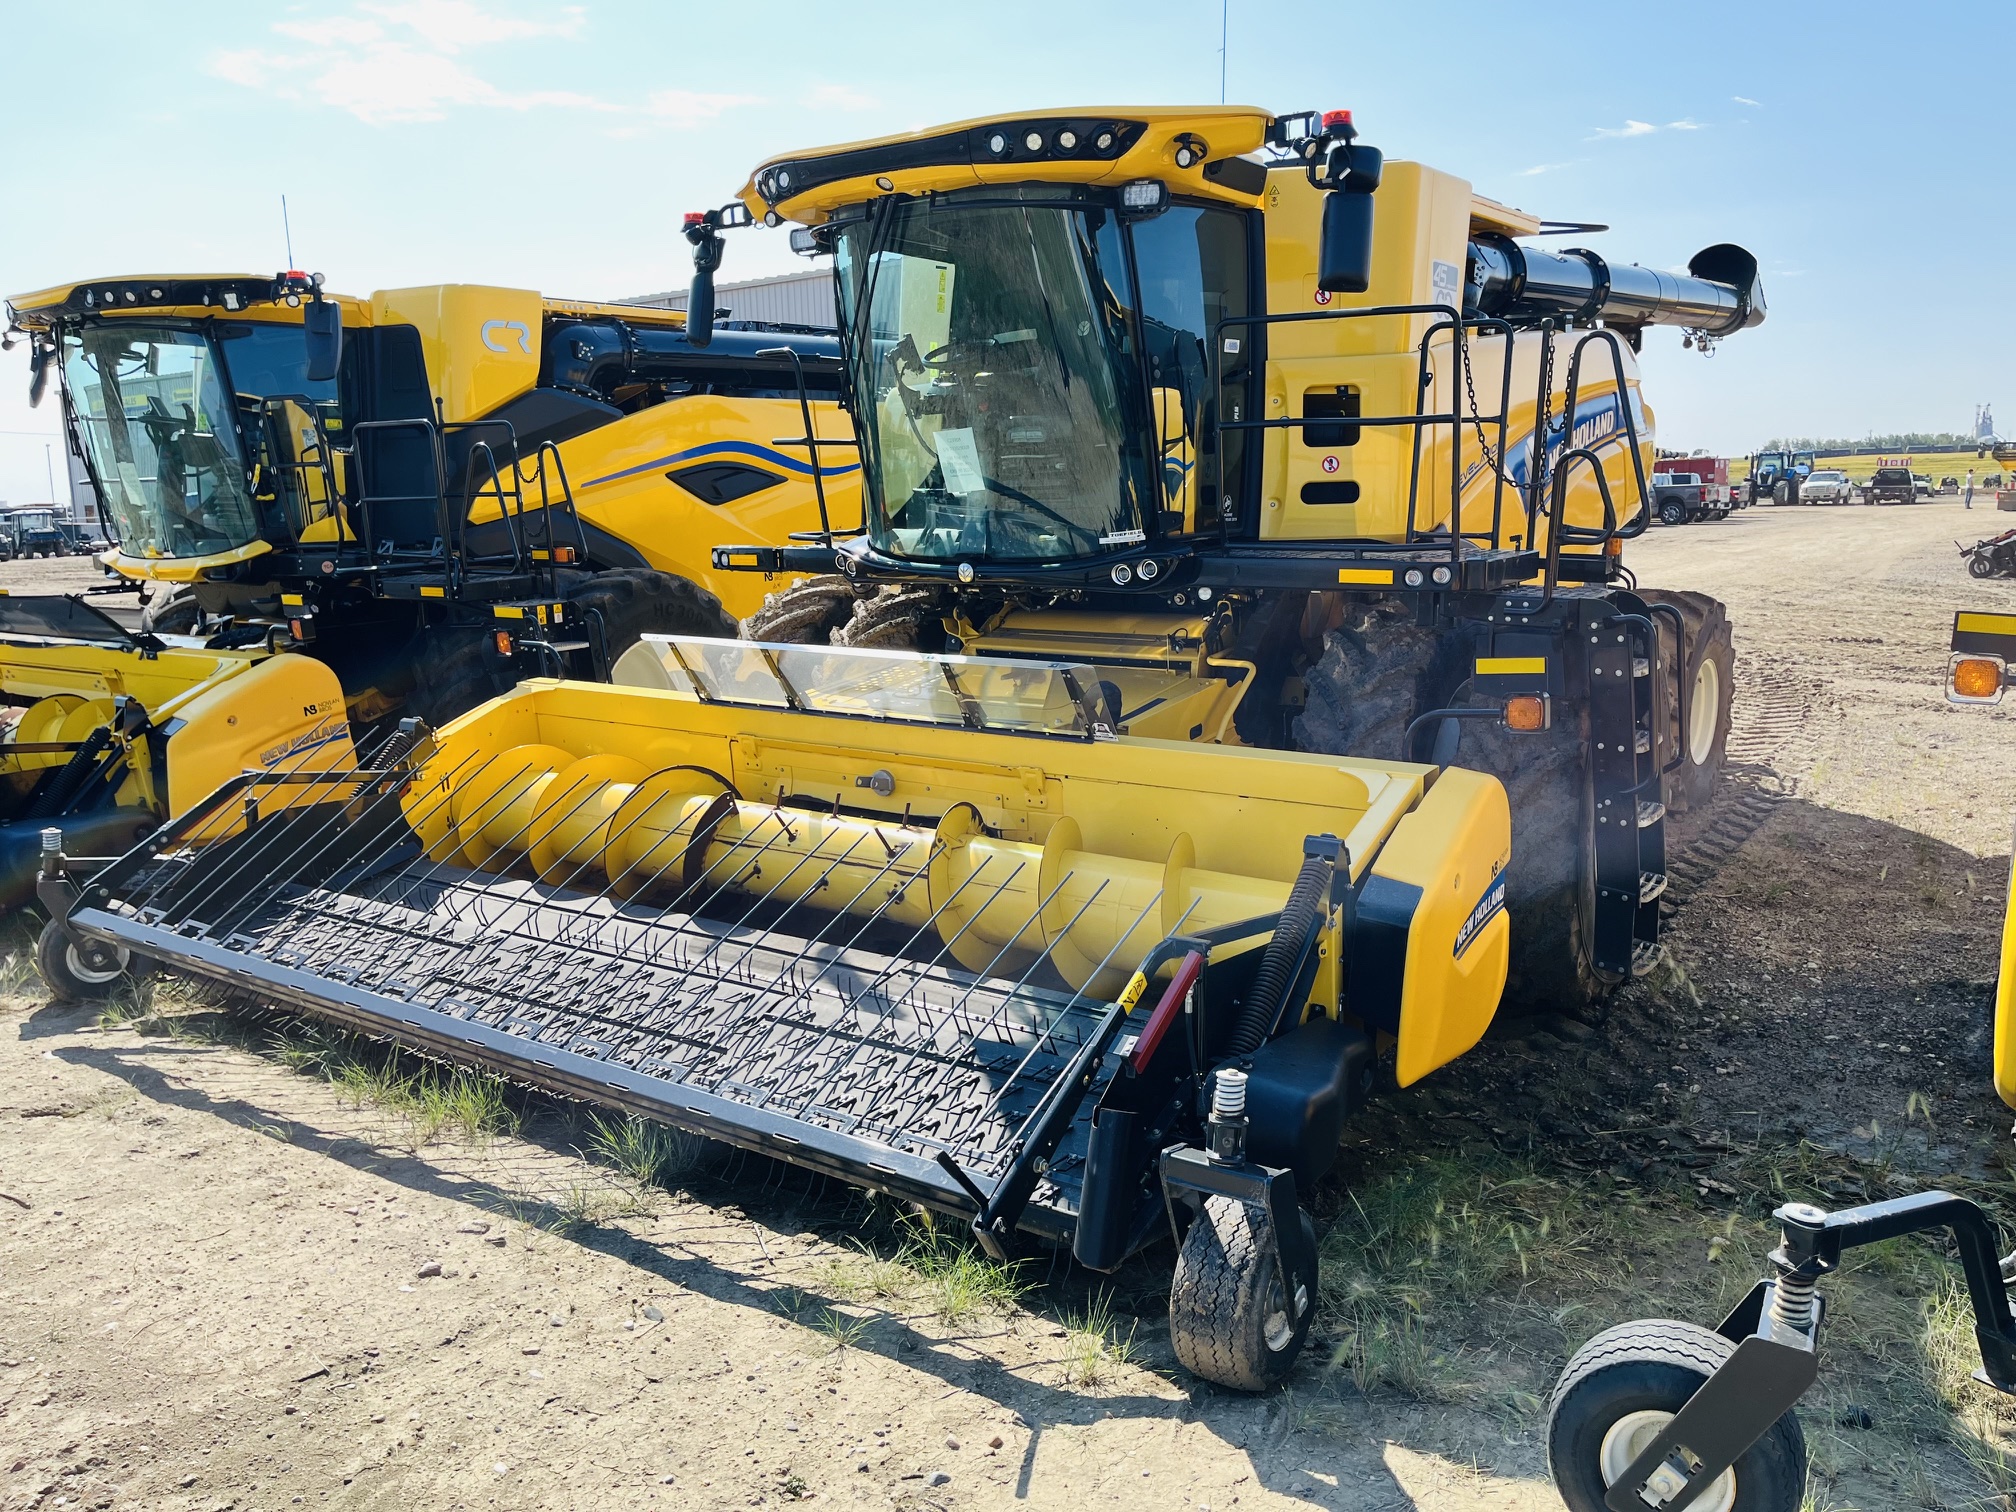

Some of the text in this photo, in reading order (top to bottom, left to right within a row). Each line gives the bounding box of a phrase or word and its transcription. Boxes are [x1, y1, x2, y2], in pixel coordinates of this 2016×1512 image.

[481, 320, 532, 354] CR
[1572, 410, 1614, 449] HOLLAND
[260, 722, 347, 764] NEW HOLLAND
[1456, 912, 1475, 949] NEW
[1475, 883, 1505, 926] HOLLAND
